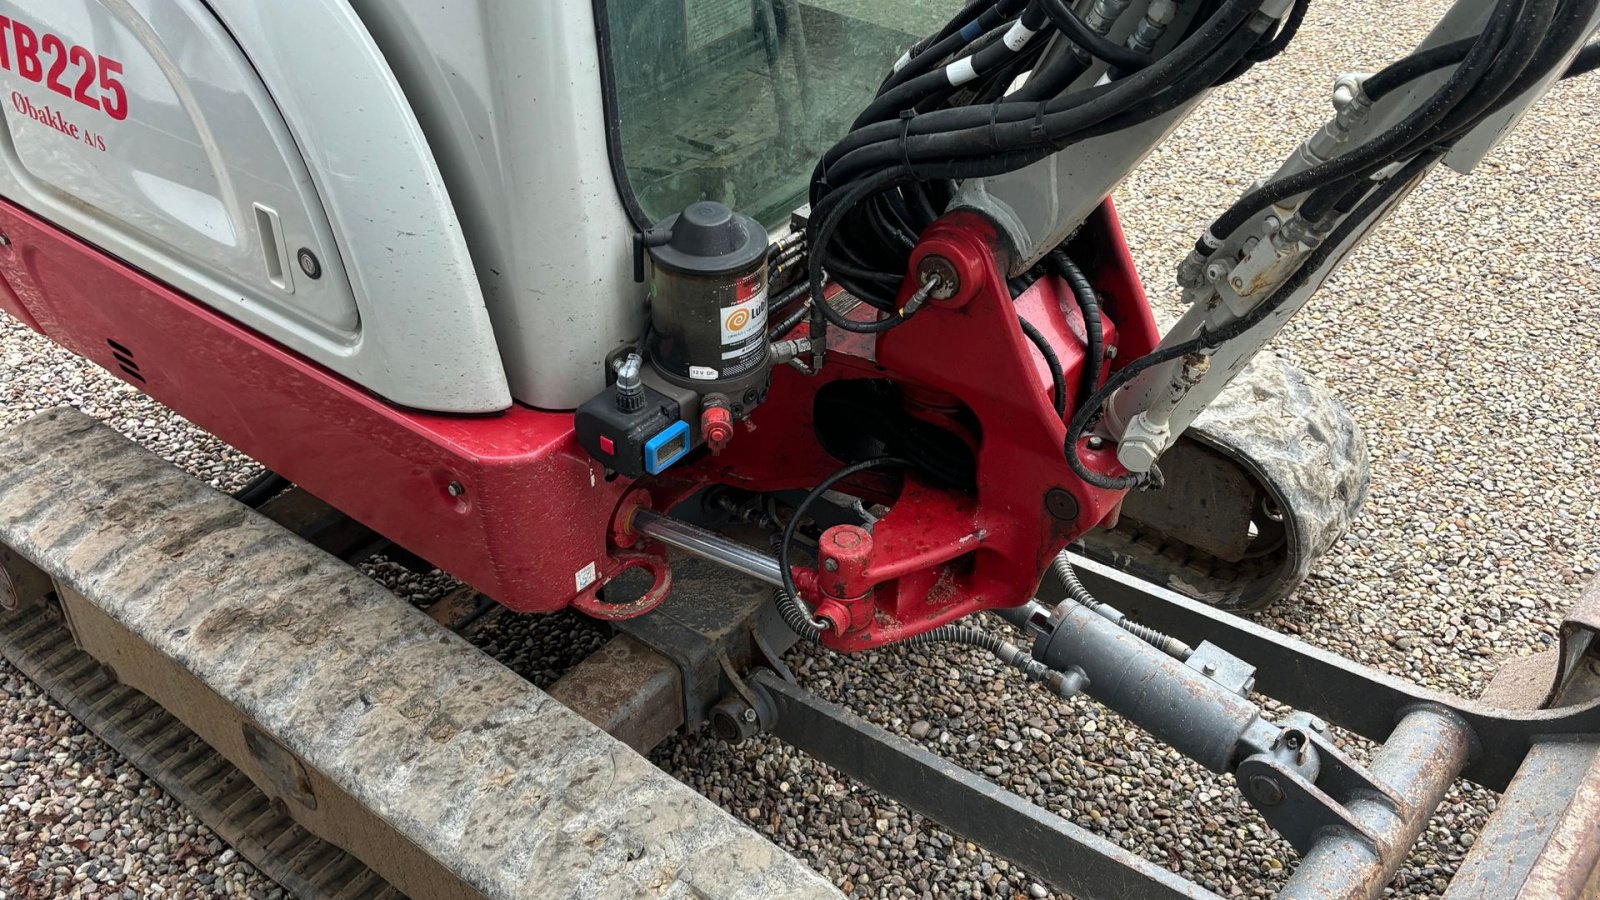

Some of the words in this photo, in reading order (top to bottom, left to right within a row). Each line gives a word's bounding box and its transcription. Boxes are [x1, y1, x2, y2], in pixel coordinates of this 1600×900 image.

[0, 15, 128, 121] TB225
[12, 91, 80, 140] Øbakke
[84, 129, 106, 152] A/S
